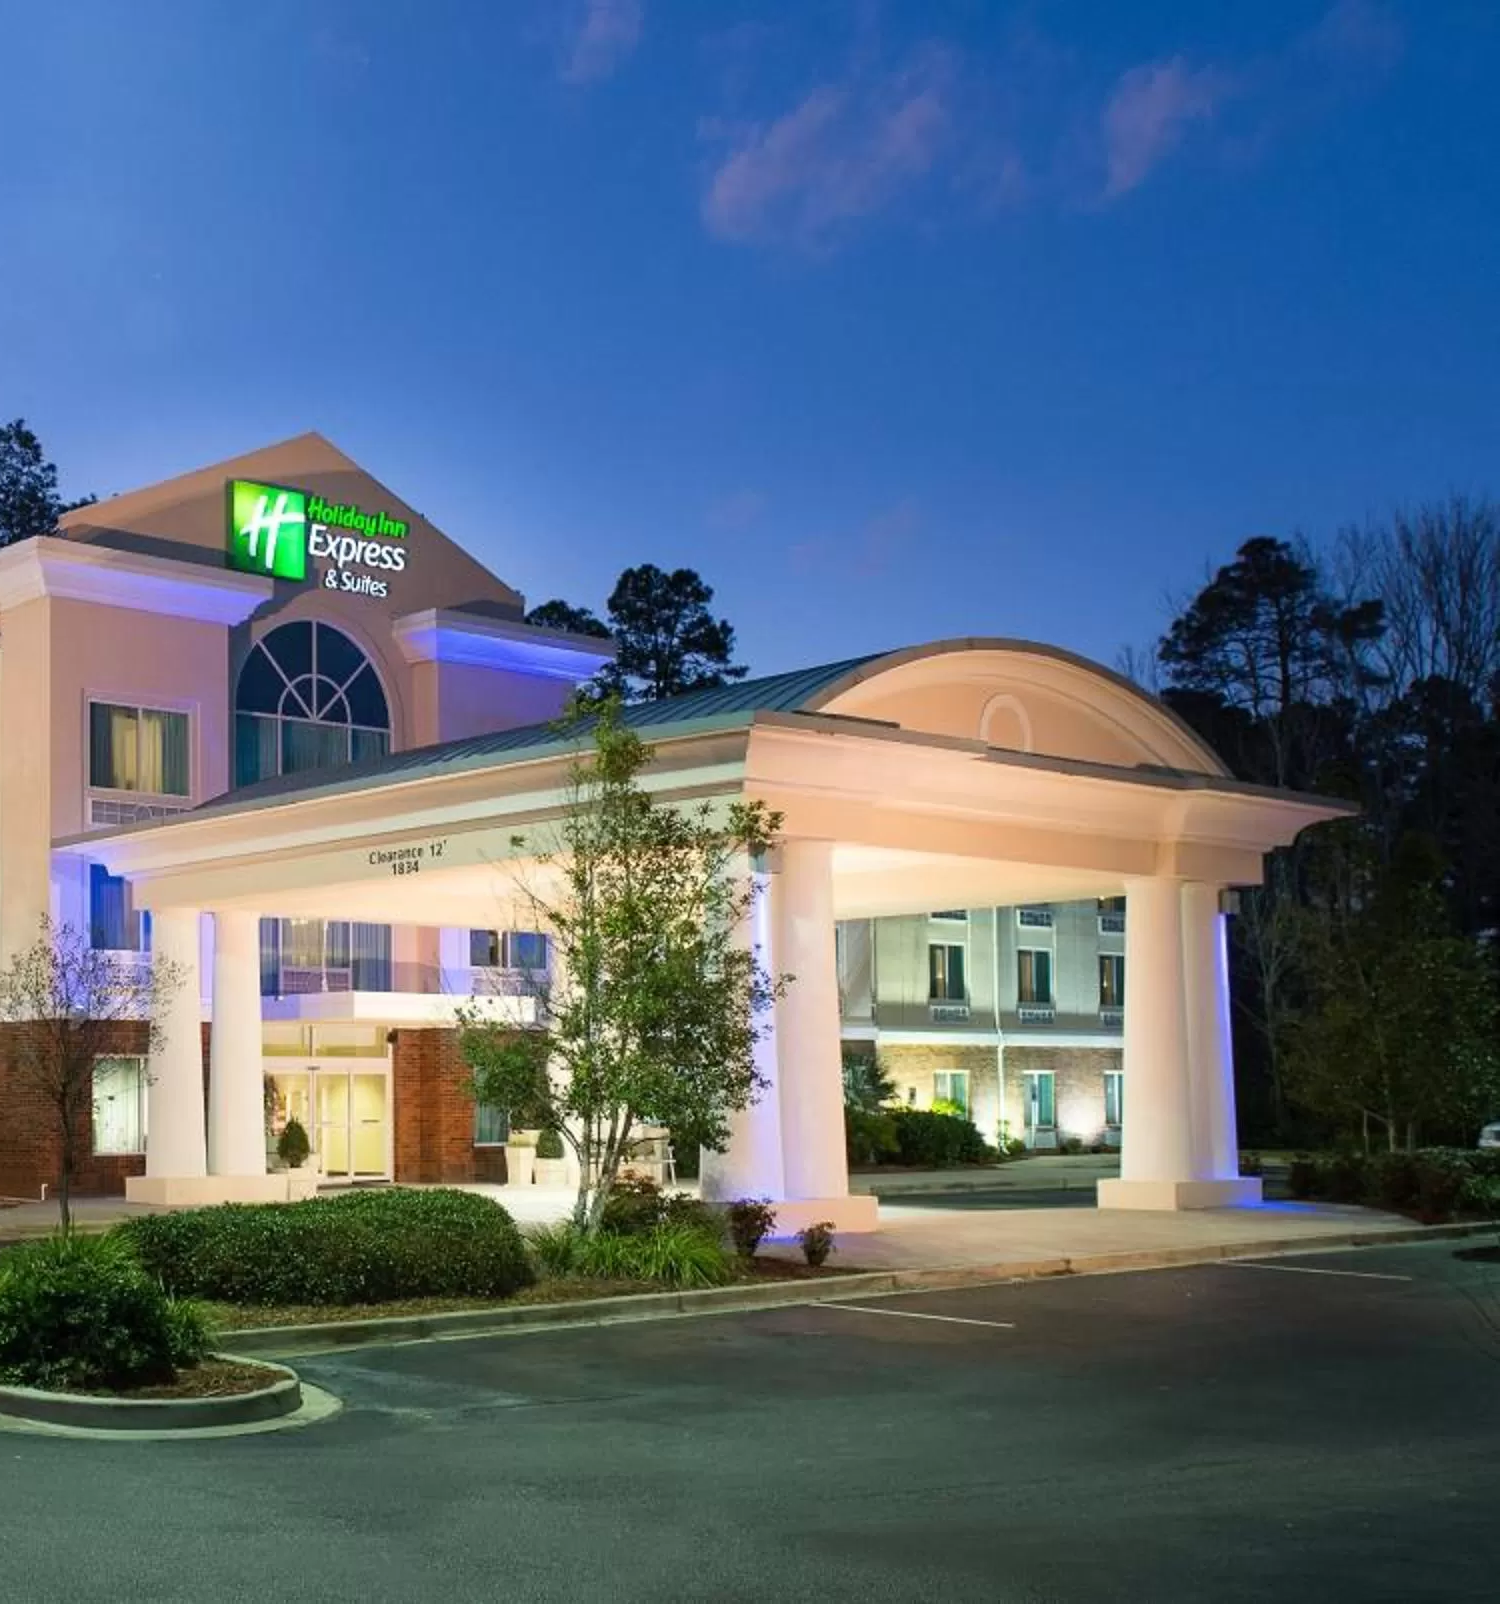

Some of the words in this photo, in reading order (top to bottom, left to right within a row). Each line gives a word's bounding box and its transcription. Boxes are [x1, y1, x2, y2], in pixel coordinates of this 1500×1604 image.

[308, 497, 377, 537] Holiday
[380, 511, 406, 538] Inn
[308, 524, 406, 571] Express
[325, 569, 338, 588] &
[341, 572, 388, 597] Suites
[369, 847, 423, 864] Clearance
[392, 859, 419, 875] 1834
